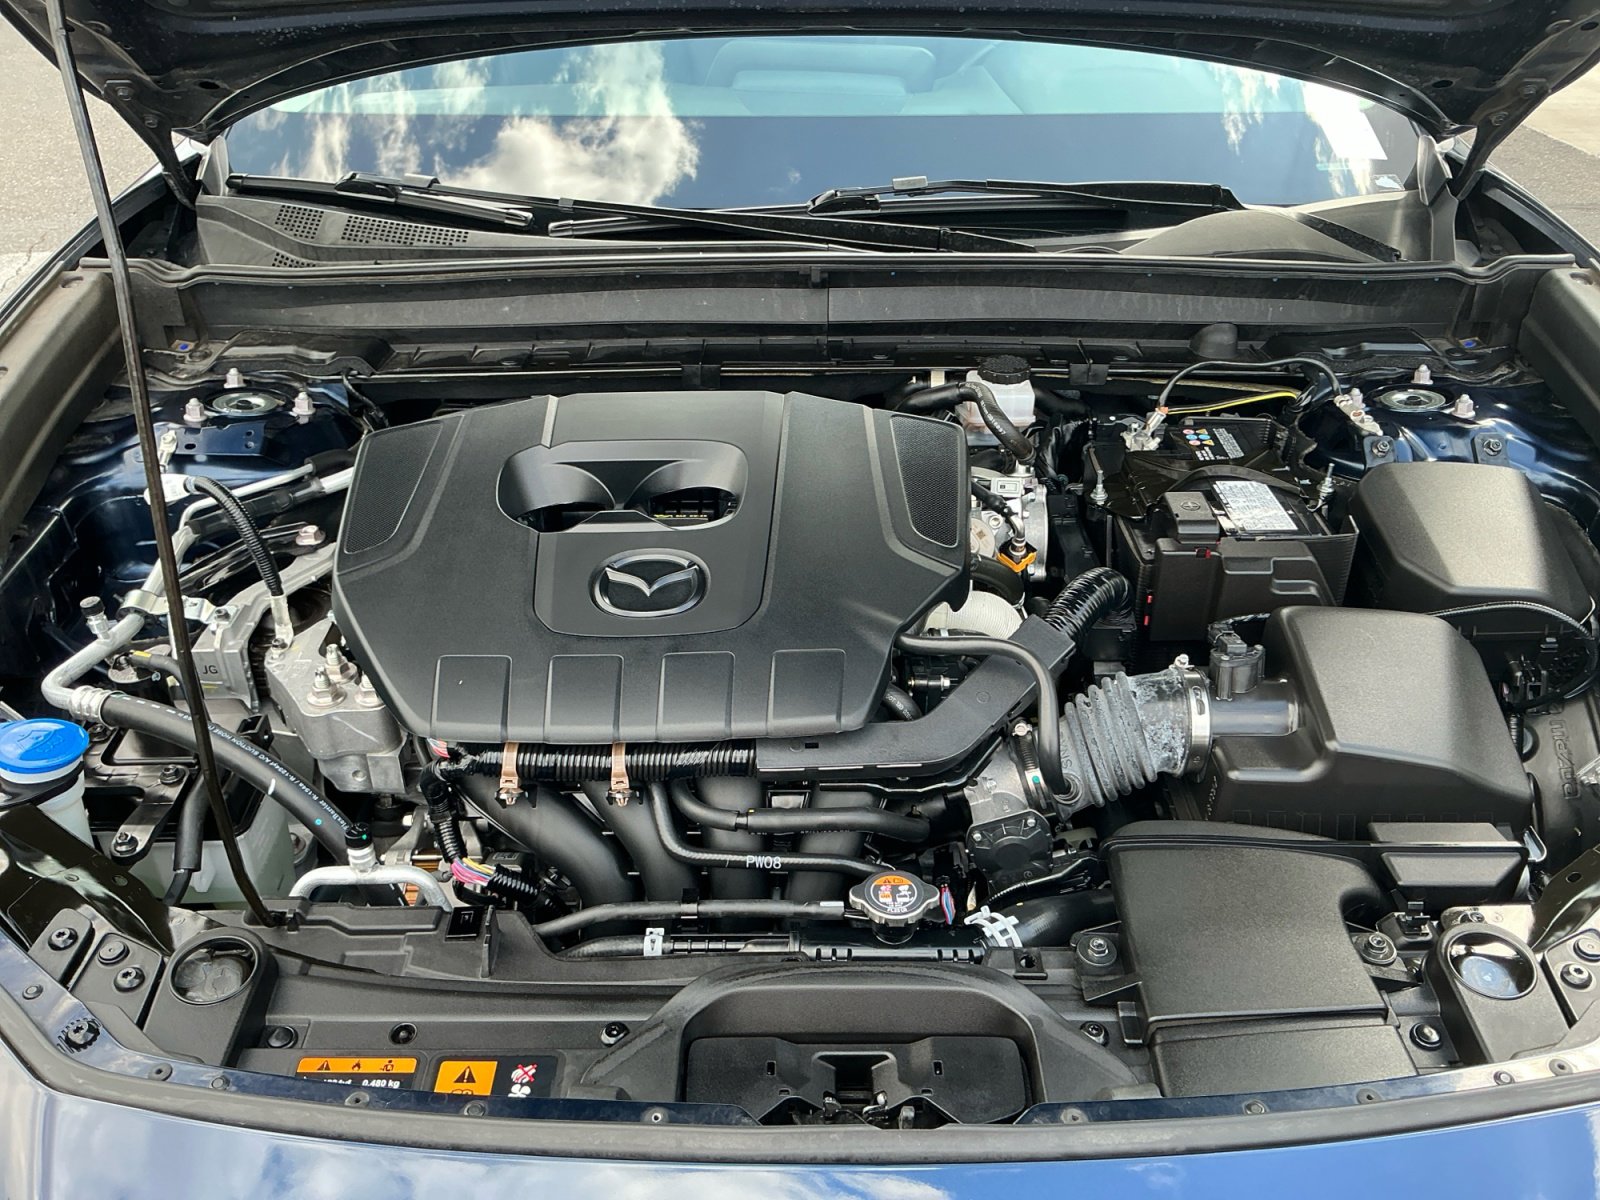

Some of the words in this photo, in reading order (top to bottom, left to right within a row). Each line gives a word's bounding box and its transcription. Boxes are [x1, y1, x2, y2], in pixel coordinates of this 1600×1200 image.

[202, 664, 218, 674] JG
[214, 727, 232, 741] HOSE
[231, 734, 258, 756] SUCTION
[361, 1079, 387, 1088] 0.480
[387, 1079, 401, 1089] kg
